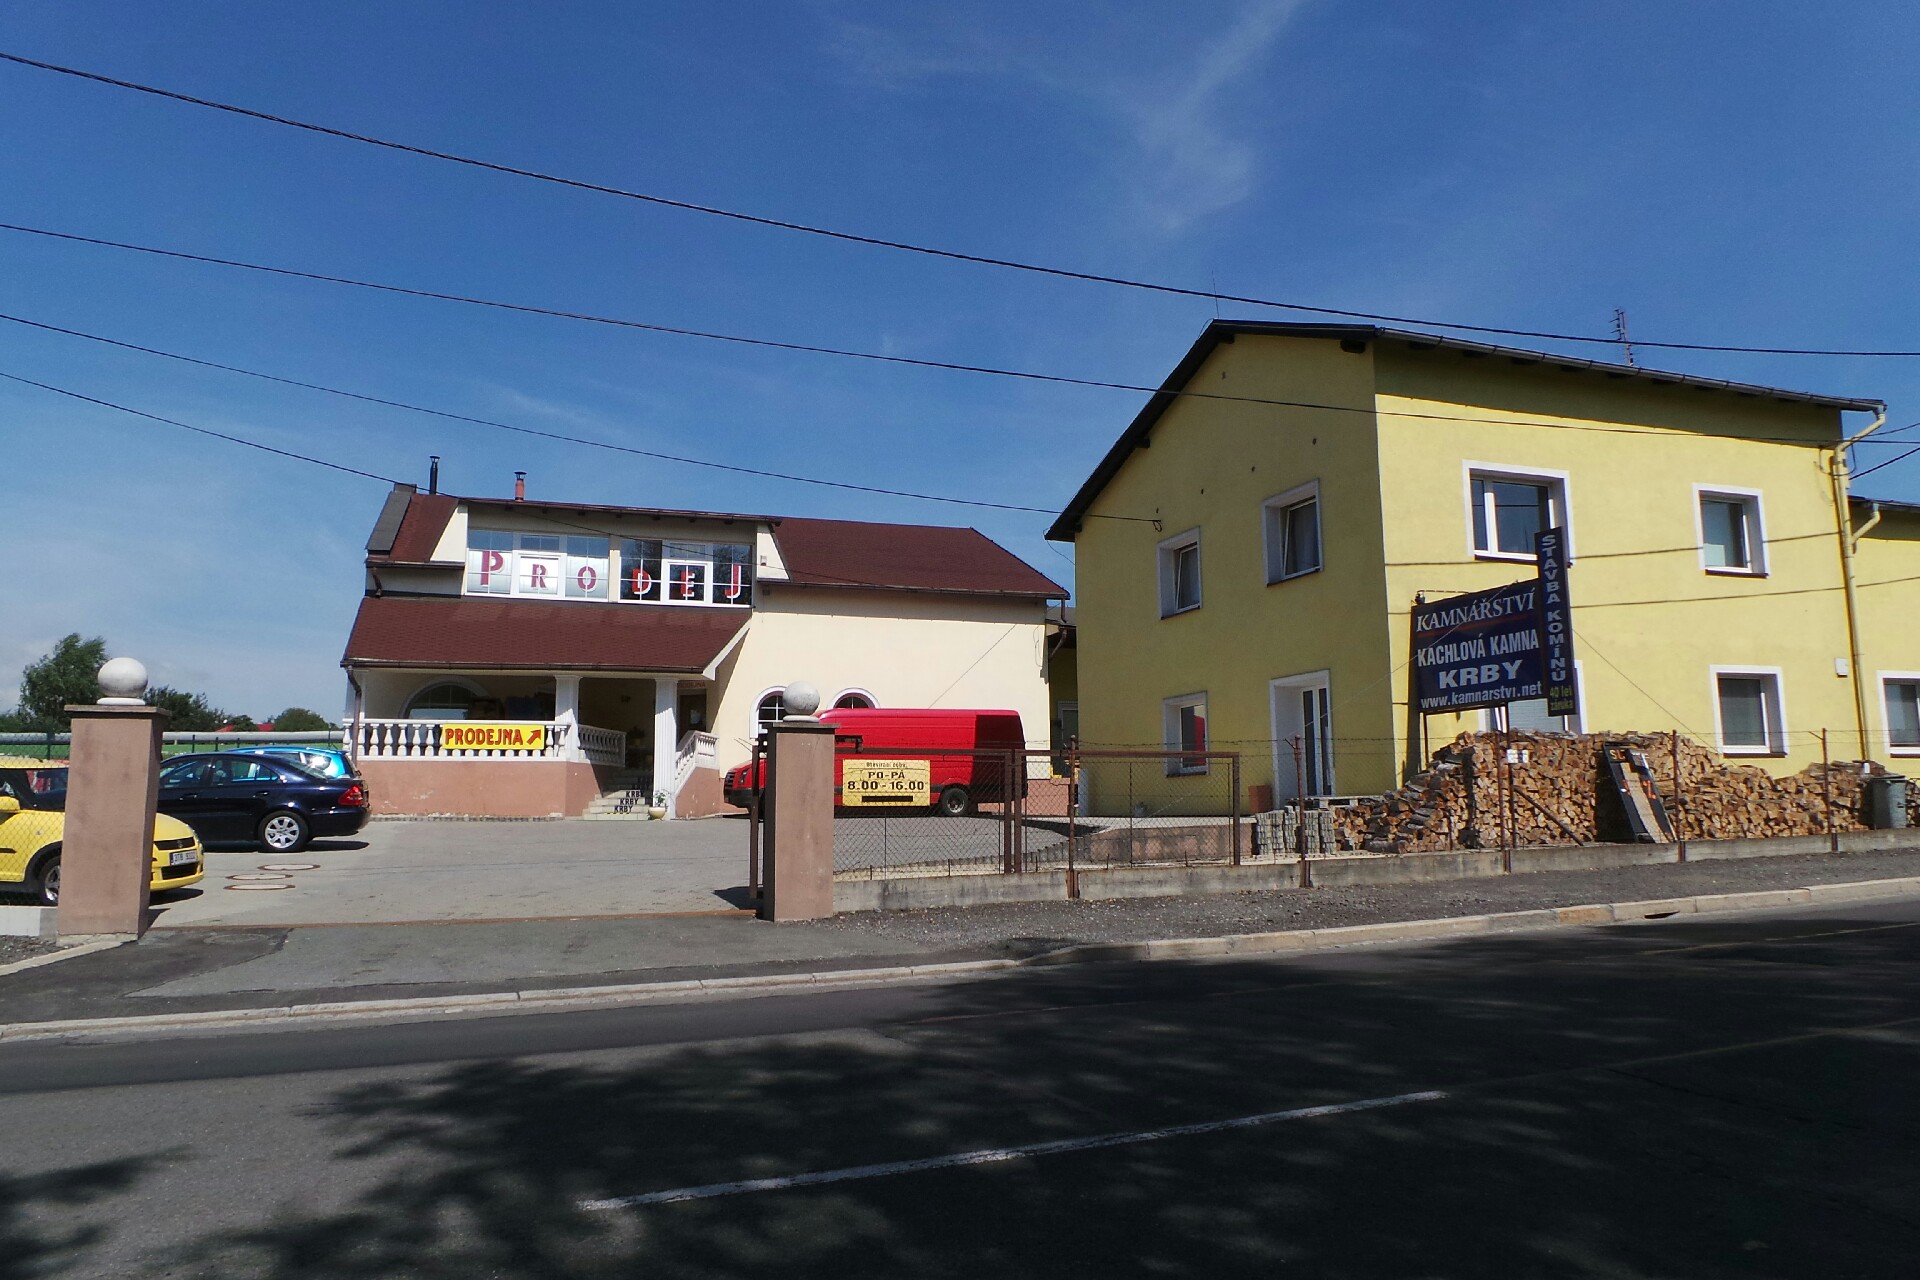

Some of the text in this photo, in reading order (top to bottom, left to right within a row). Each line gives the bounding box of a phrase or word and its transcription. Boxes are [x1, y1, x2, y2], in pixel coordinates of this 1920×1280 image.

[1416, 587, 1536, 632] KAMNÁŘSTVÍ
[1542, 534, 1567, 682] STAVBA KOMÍNŮ
[1417, 628, 1540, 667] KACHLOVÁ KAMNA
[1438, 659, 1523, 689] KRBY
[1420, 681, 1542, 708] www.kamnarstvi.net
[444, 728, 524, 746] PRODEJNA
[848, 780, 878, 790] 8.00
[890, 780, 924, 790] 16.00
[614, 805, 633, 813] KRBY
